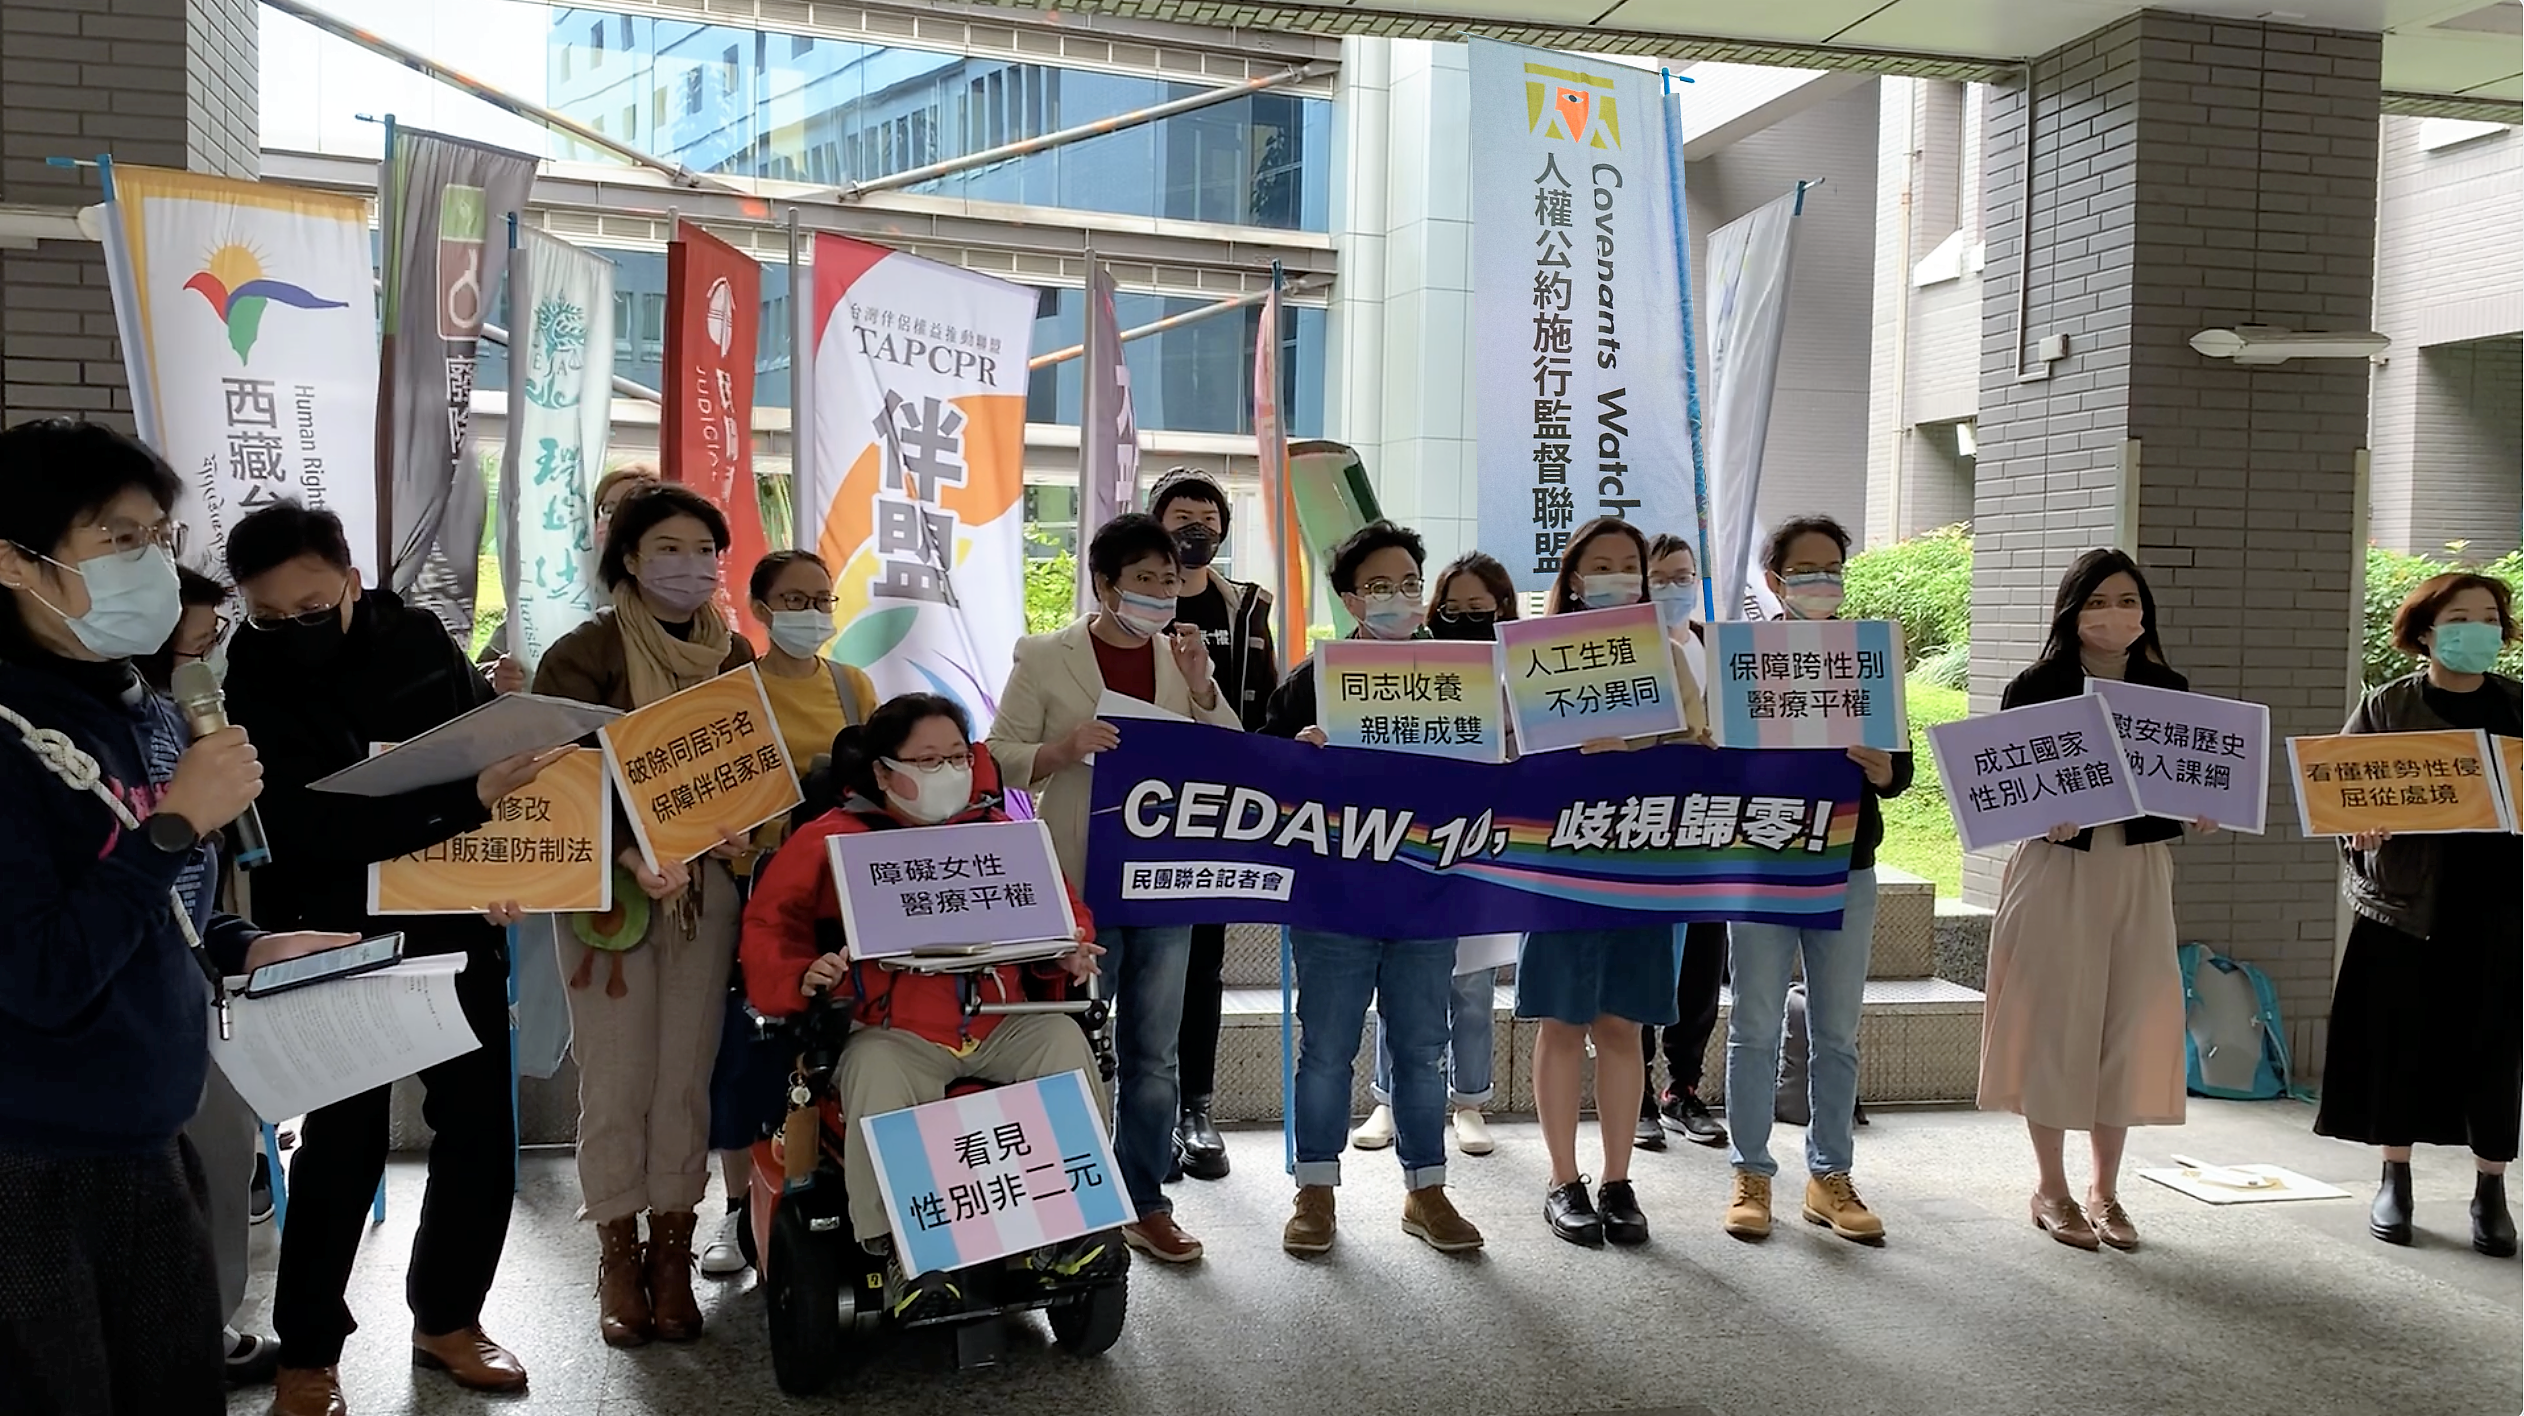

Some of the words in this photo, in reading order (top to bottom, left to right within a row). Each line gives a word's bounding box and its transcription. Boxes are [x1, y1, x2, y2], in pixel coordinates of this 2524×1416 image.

[1591, 162, 1623, 370] Covenants
[850, 302, 1002, 355] 台灣伴侶權益推動聯盟
[852, 325, 998, 387] TAPCPR
[1532, 151, 1574, 574] 人權公約施行監督聯盟
[294, 385, 316, 452] Human
[1596, 388, 1642, 521] Watch
[300, 457, 327, 510] Right
[871, 388, 965, 609] 伴盟
[1524, 636, 1637, 679] 人工生殖
[1729, 650, 1885, 681] 保障跨性別
[1341, 673, 1463, 703] 同志收養
[1547, 676, 1661, 718] 不分異同
[1746, 688, 1872, 720] 醫療平權
[625, 710, 755, 786] 破除同居污名
[1360, 716, 1485, 747] 親權成雙
[1973, 729, 2089, 777] 成立國家
[2110, 713, 2247, 761] 慰安婦歷史
[651, 743, 782, 825] 保障伴侶家庭
[1969, 762, 2114, 813] 性別人權館
[2307, 757, 2481, 783] 看懂權勢性侵
[494, 796, 552, 822] 修改
[2341, 785, 2458, 808] 屈從處境
[1123, 779, 1414, 863] CEDAW
[1551, 793, 1833, 854] 歧視歸零!
[869, 853, 1006, 886] 障礙女性
[1131, 868, 1284, 893] 民團聯合記者會
[900, 881, 1038, 918] 醫療平權
[953, 1122, 1032, 1169] 看見
[909, 1152, 1104, 1232] 性別非二元
